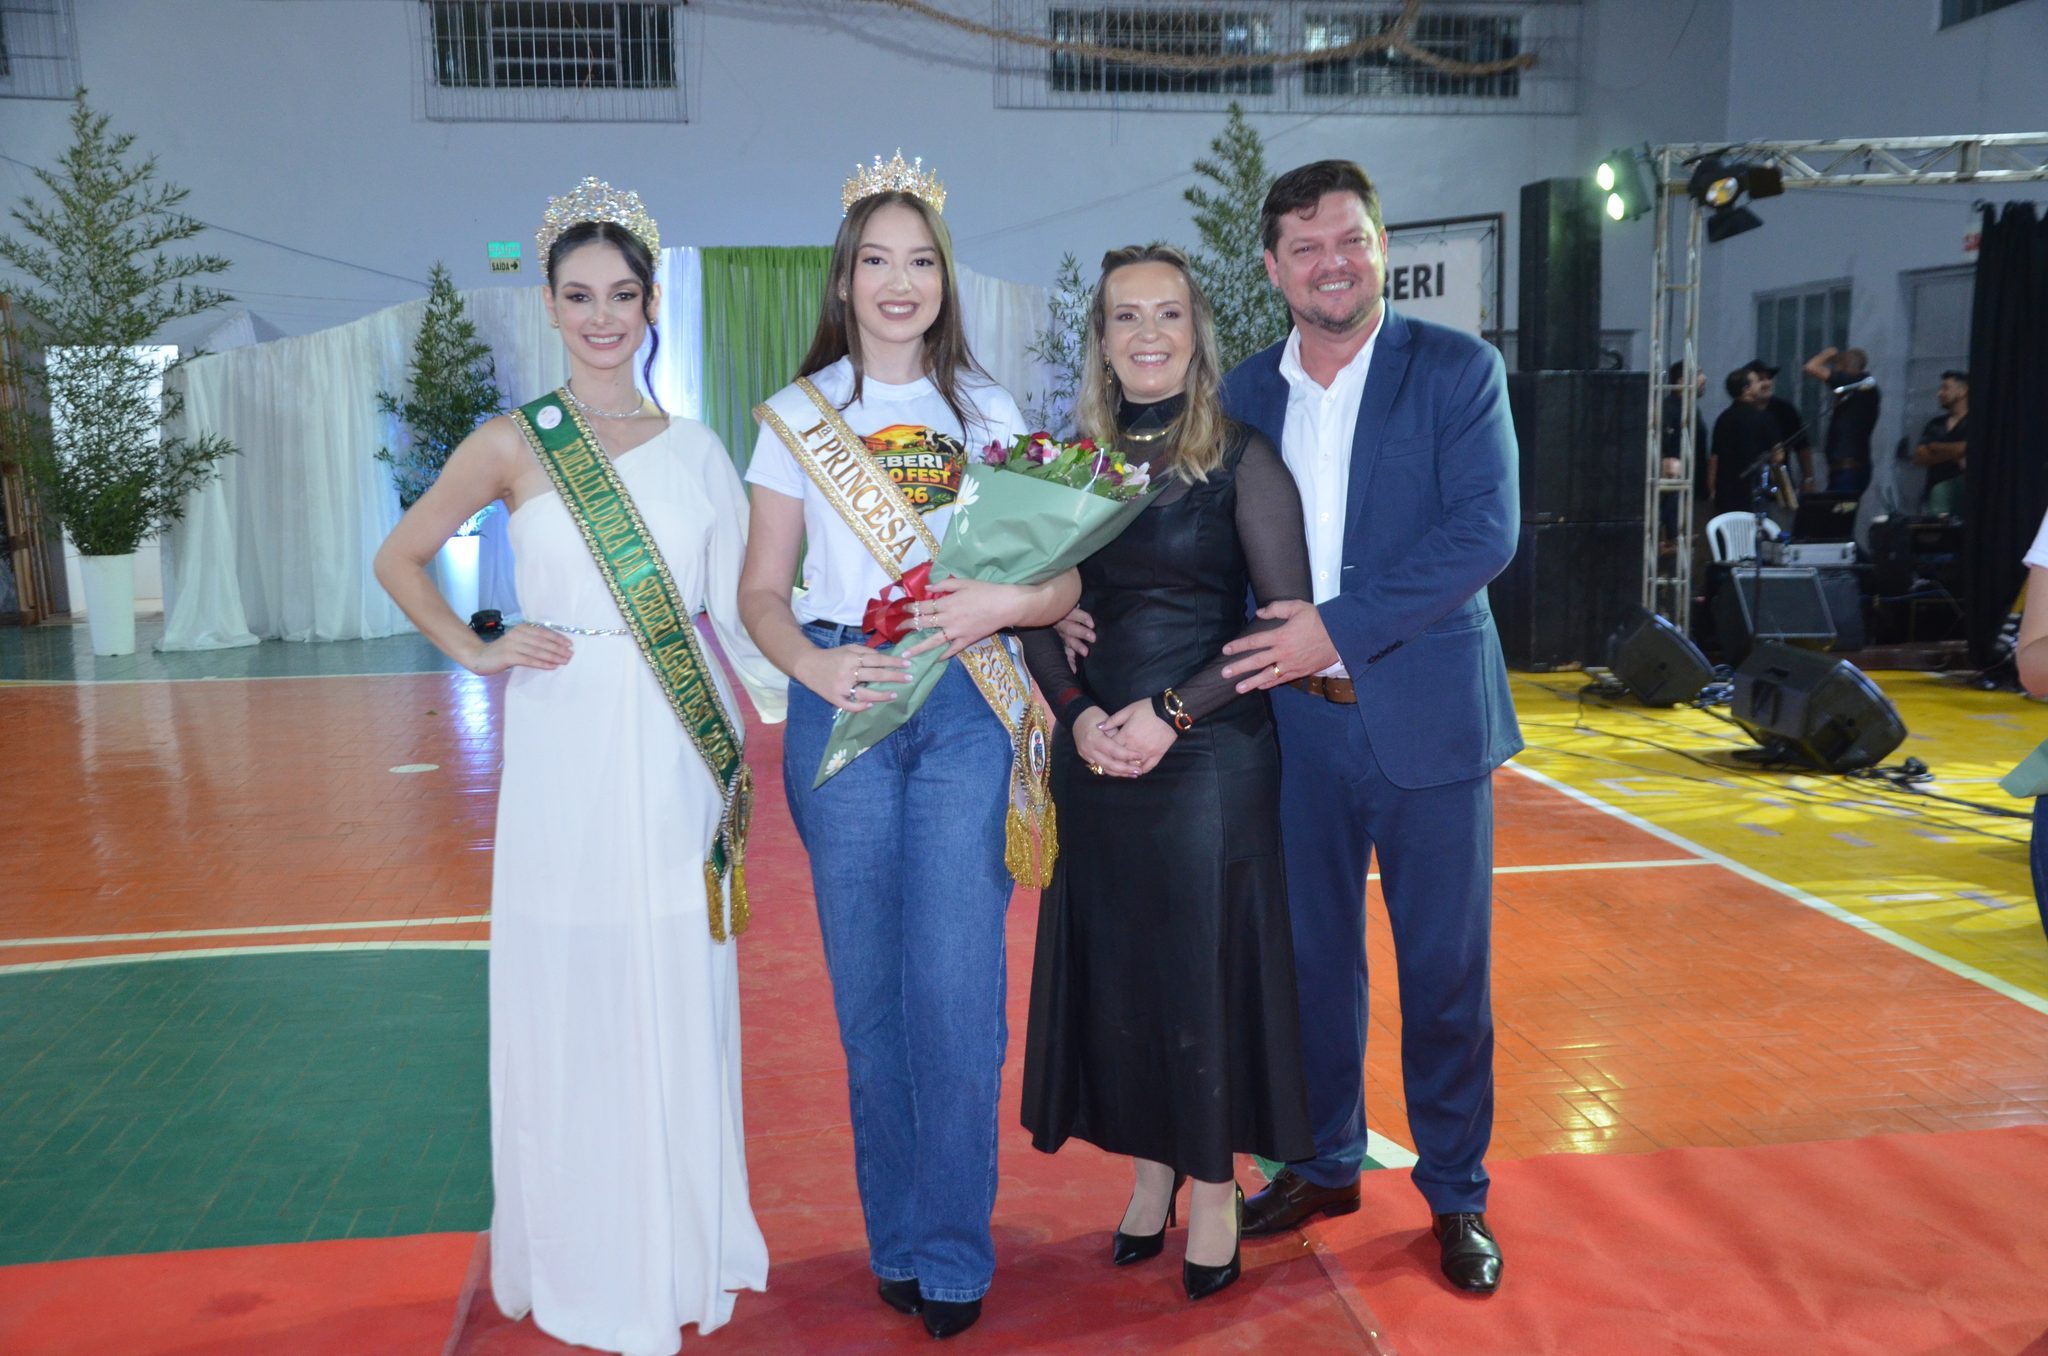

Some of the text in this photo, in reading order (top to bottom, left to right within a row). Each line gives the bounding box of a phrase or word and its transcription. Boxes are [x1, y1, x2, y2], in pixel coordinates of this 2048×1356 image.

[552, 438, 635, 554] EMBAIXADORA
[811, 434, 917, 565] PRINCESA
[906, 468, 951, 484] FEST
[613, 547, 649, 580] DA
[627, 575, 677, 643] SEBERI
[981, 644, 1019, 702] AGRO
